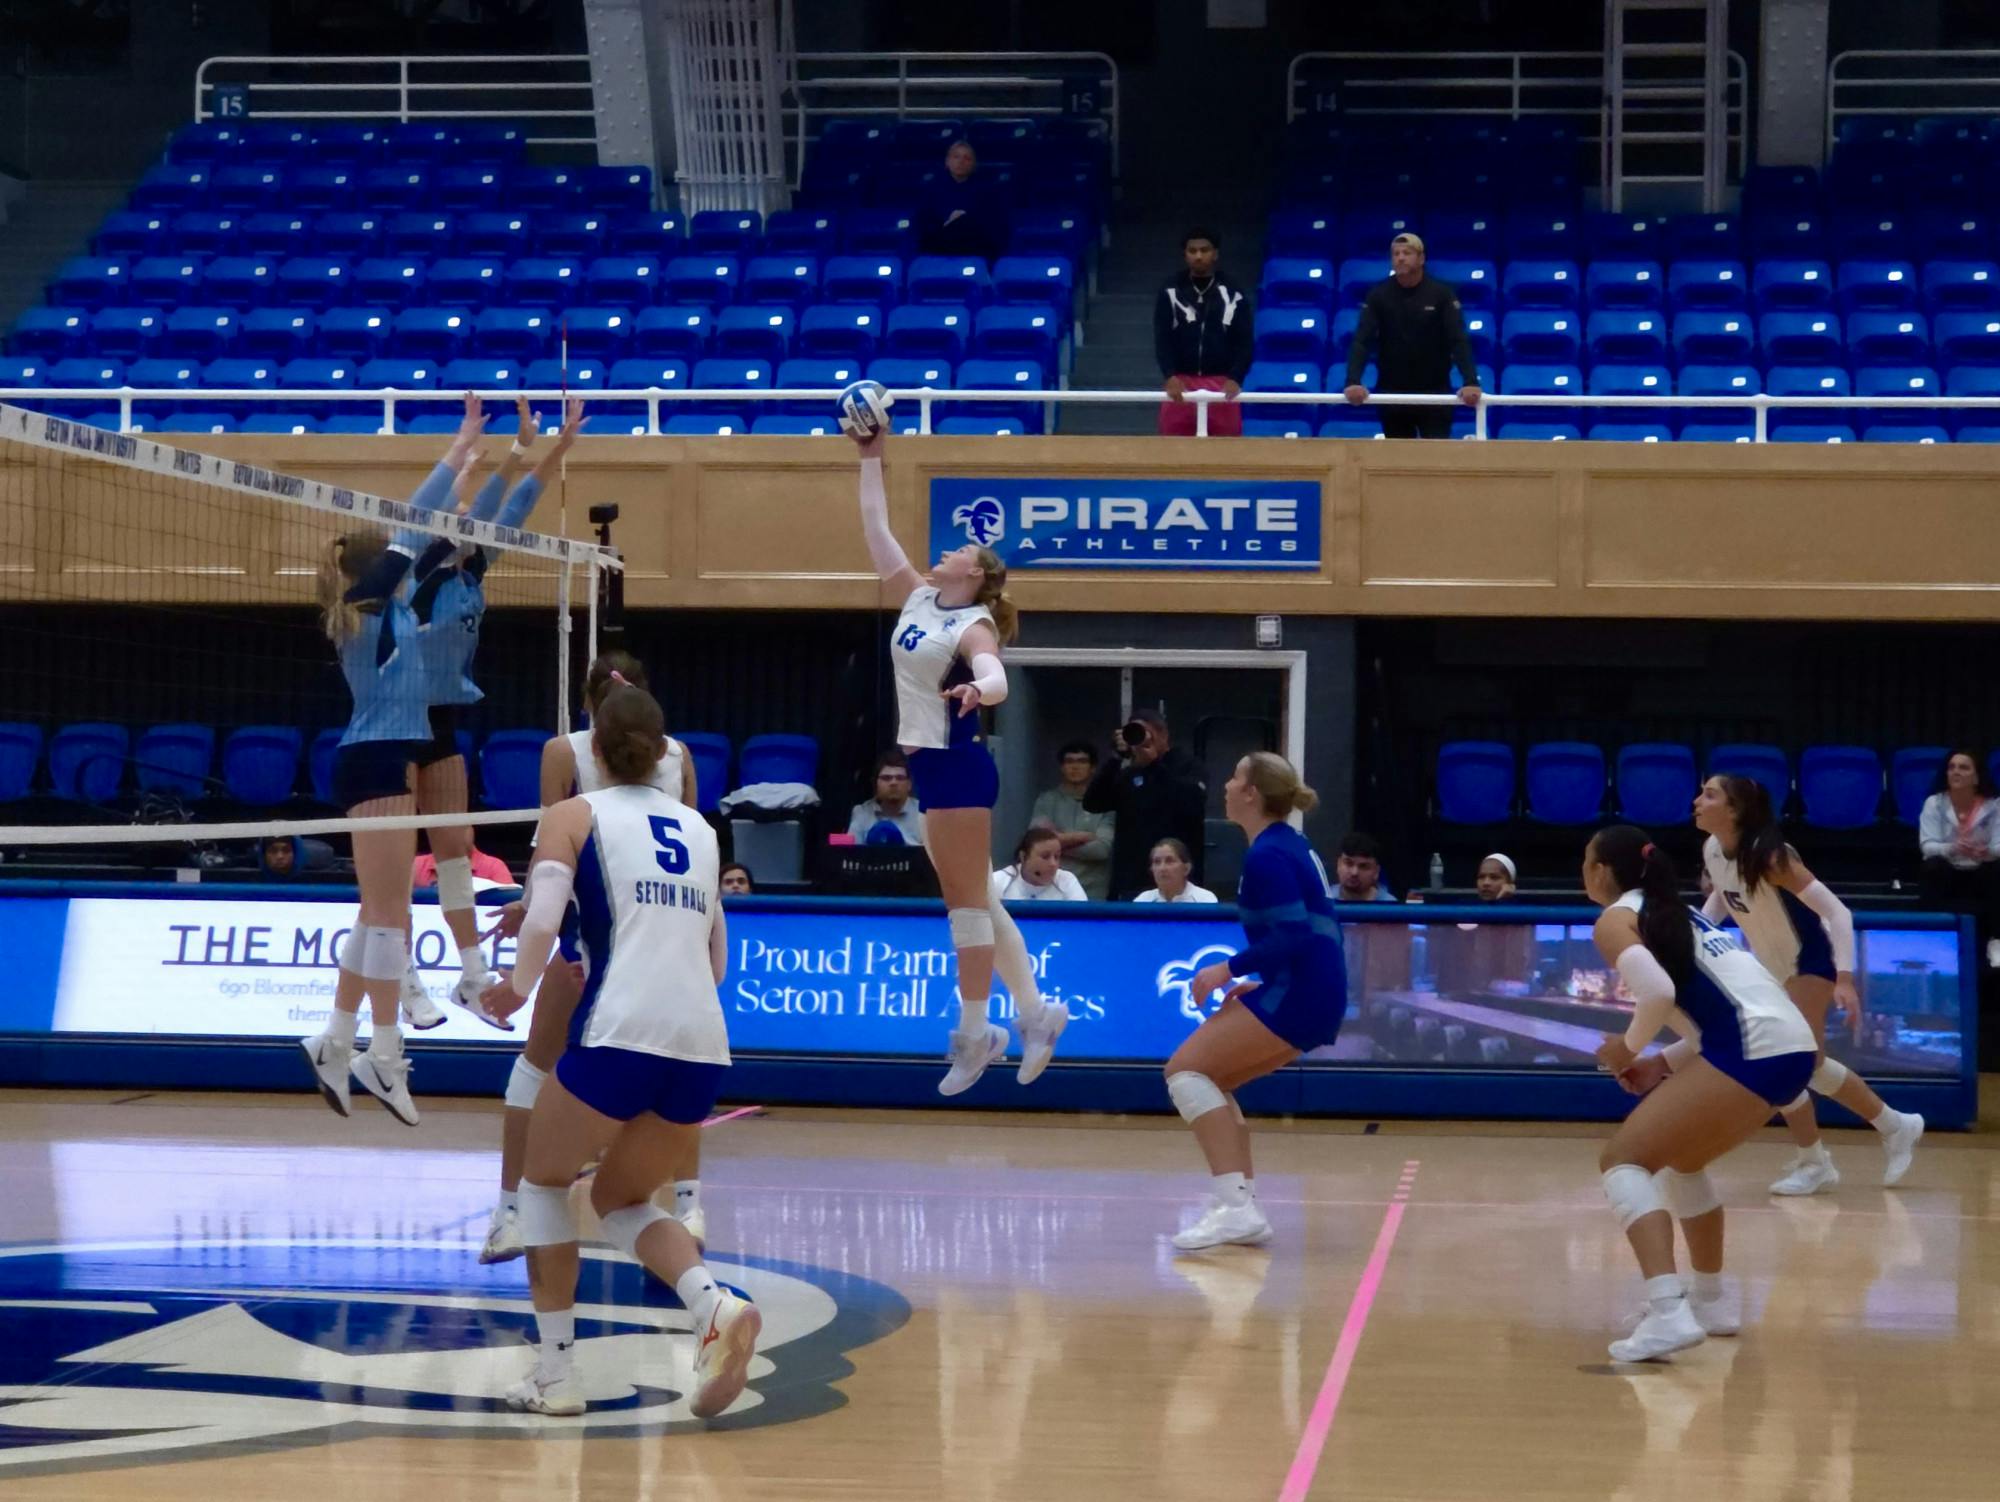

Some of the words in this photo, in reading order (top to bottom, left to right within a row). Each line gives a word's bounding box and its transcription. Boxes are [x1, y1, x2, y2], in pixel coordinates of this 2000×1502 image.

[221, 96, 243, 116] 15
[1071, 93, 1094, 112] 15
[1020, 497, 1298, 531] PIRATE
[1018, 537, 1297, 551] ATHLETICS
[897, 624, 927, 651] 13
[648, 815, 691, 875] 5
[636, 881, 676, 907] SETON
[682, 886, 707, 915] HALL
[169, 925, 272, 964] THE
[739, 937, 851, 974] Proud
[218, 978, 250, 998] 690
[252, 976, 337, 996] Bloomfiel
[736, 979, 845, 1014] Seton
[857, 979, 927, 1017] Hall
